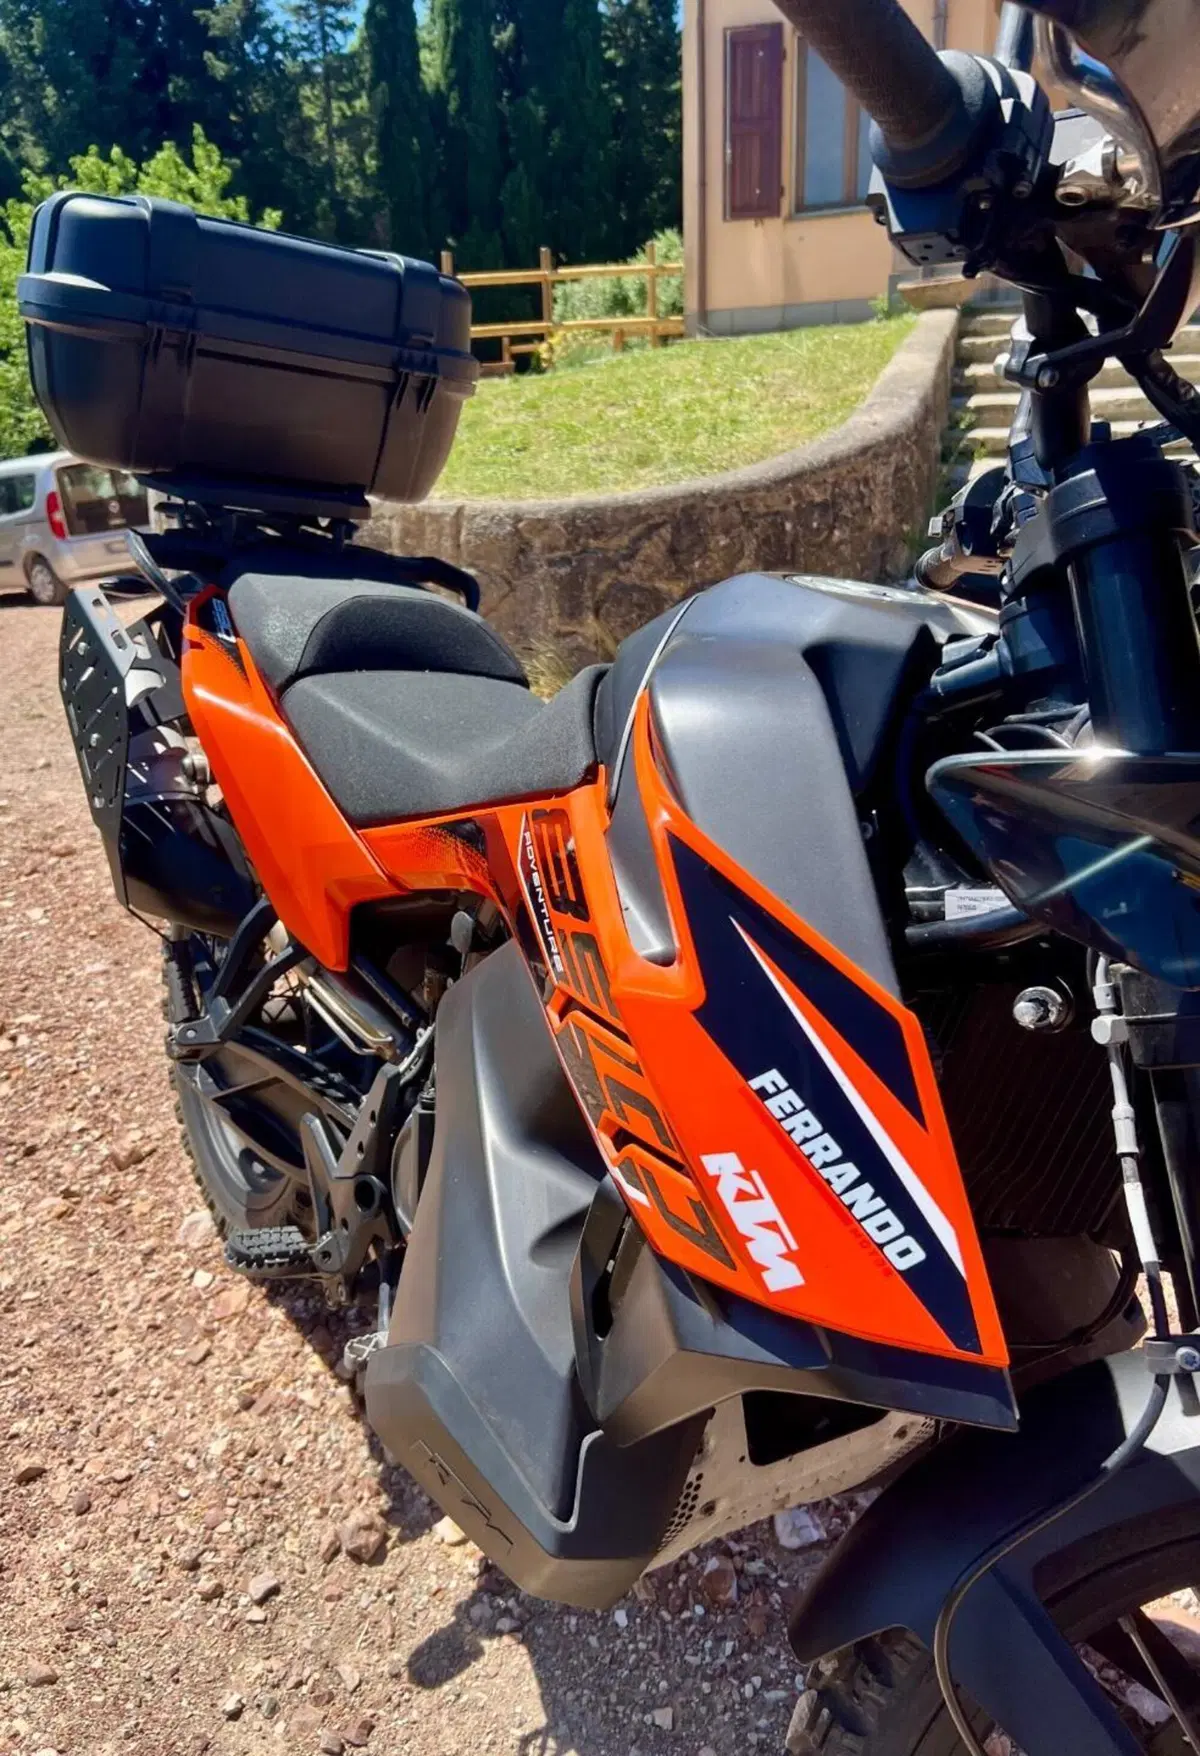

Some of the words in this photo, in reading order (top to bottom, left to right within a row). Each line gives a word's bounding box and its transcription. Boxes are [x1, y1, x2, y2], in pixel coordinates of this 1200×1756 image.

[523, 832, 564, 974] ADVENTURE
[699, 1152, 806, 1293] KTM
[747, 1068, 927, 1271] FERRANDO
